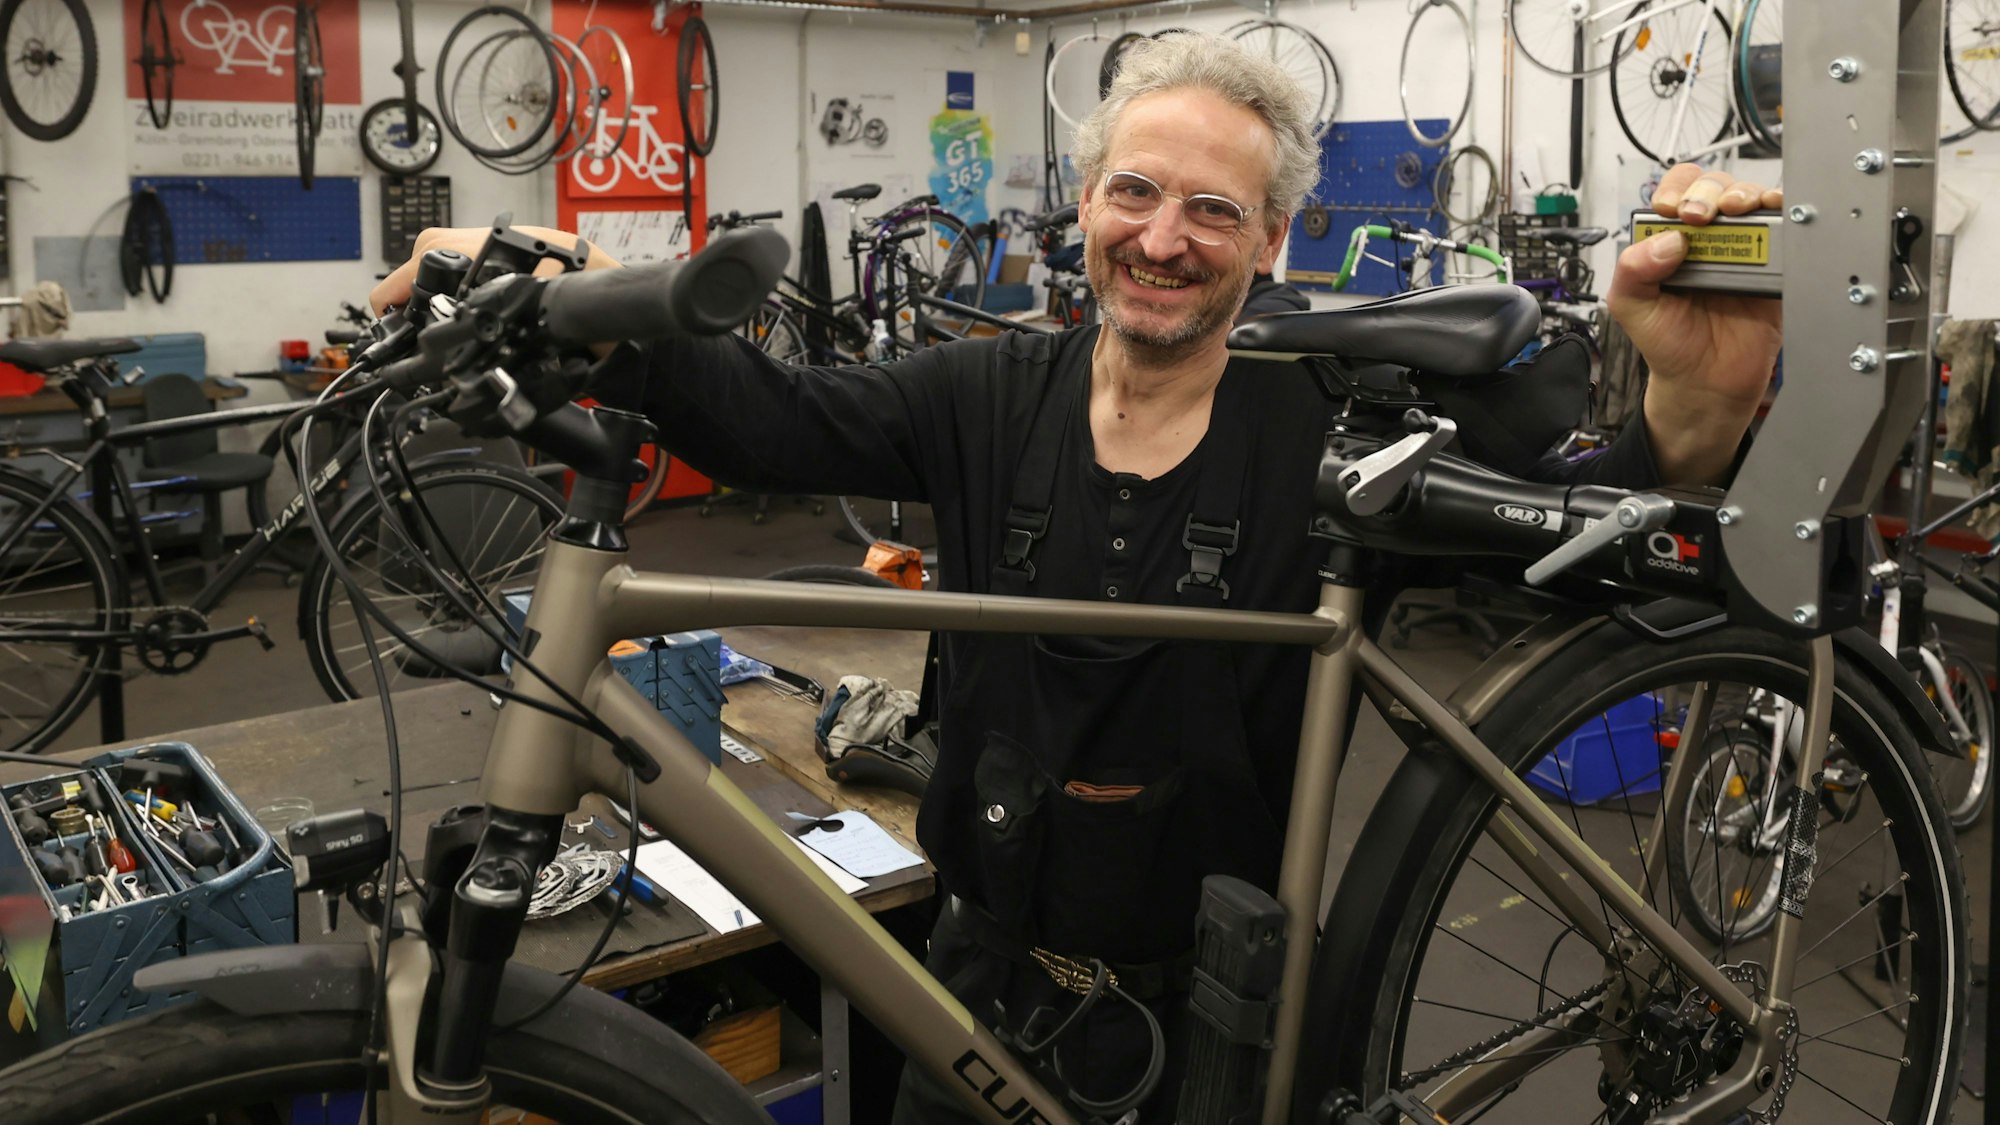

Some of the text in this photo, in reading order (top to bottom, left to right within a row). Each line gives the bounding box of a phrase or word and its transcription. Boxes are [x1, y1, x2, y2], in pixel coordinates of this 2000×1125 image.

[135, 104, 356, 130] Zeiradwerkatt
[945, 130, 982, 167] GT
[947, 161, 983, 193] 365
[1503, 506, 1537, 523] VAR
[1647, 557, 1699, 576] additive
